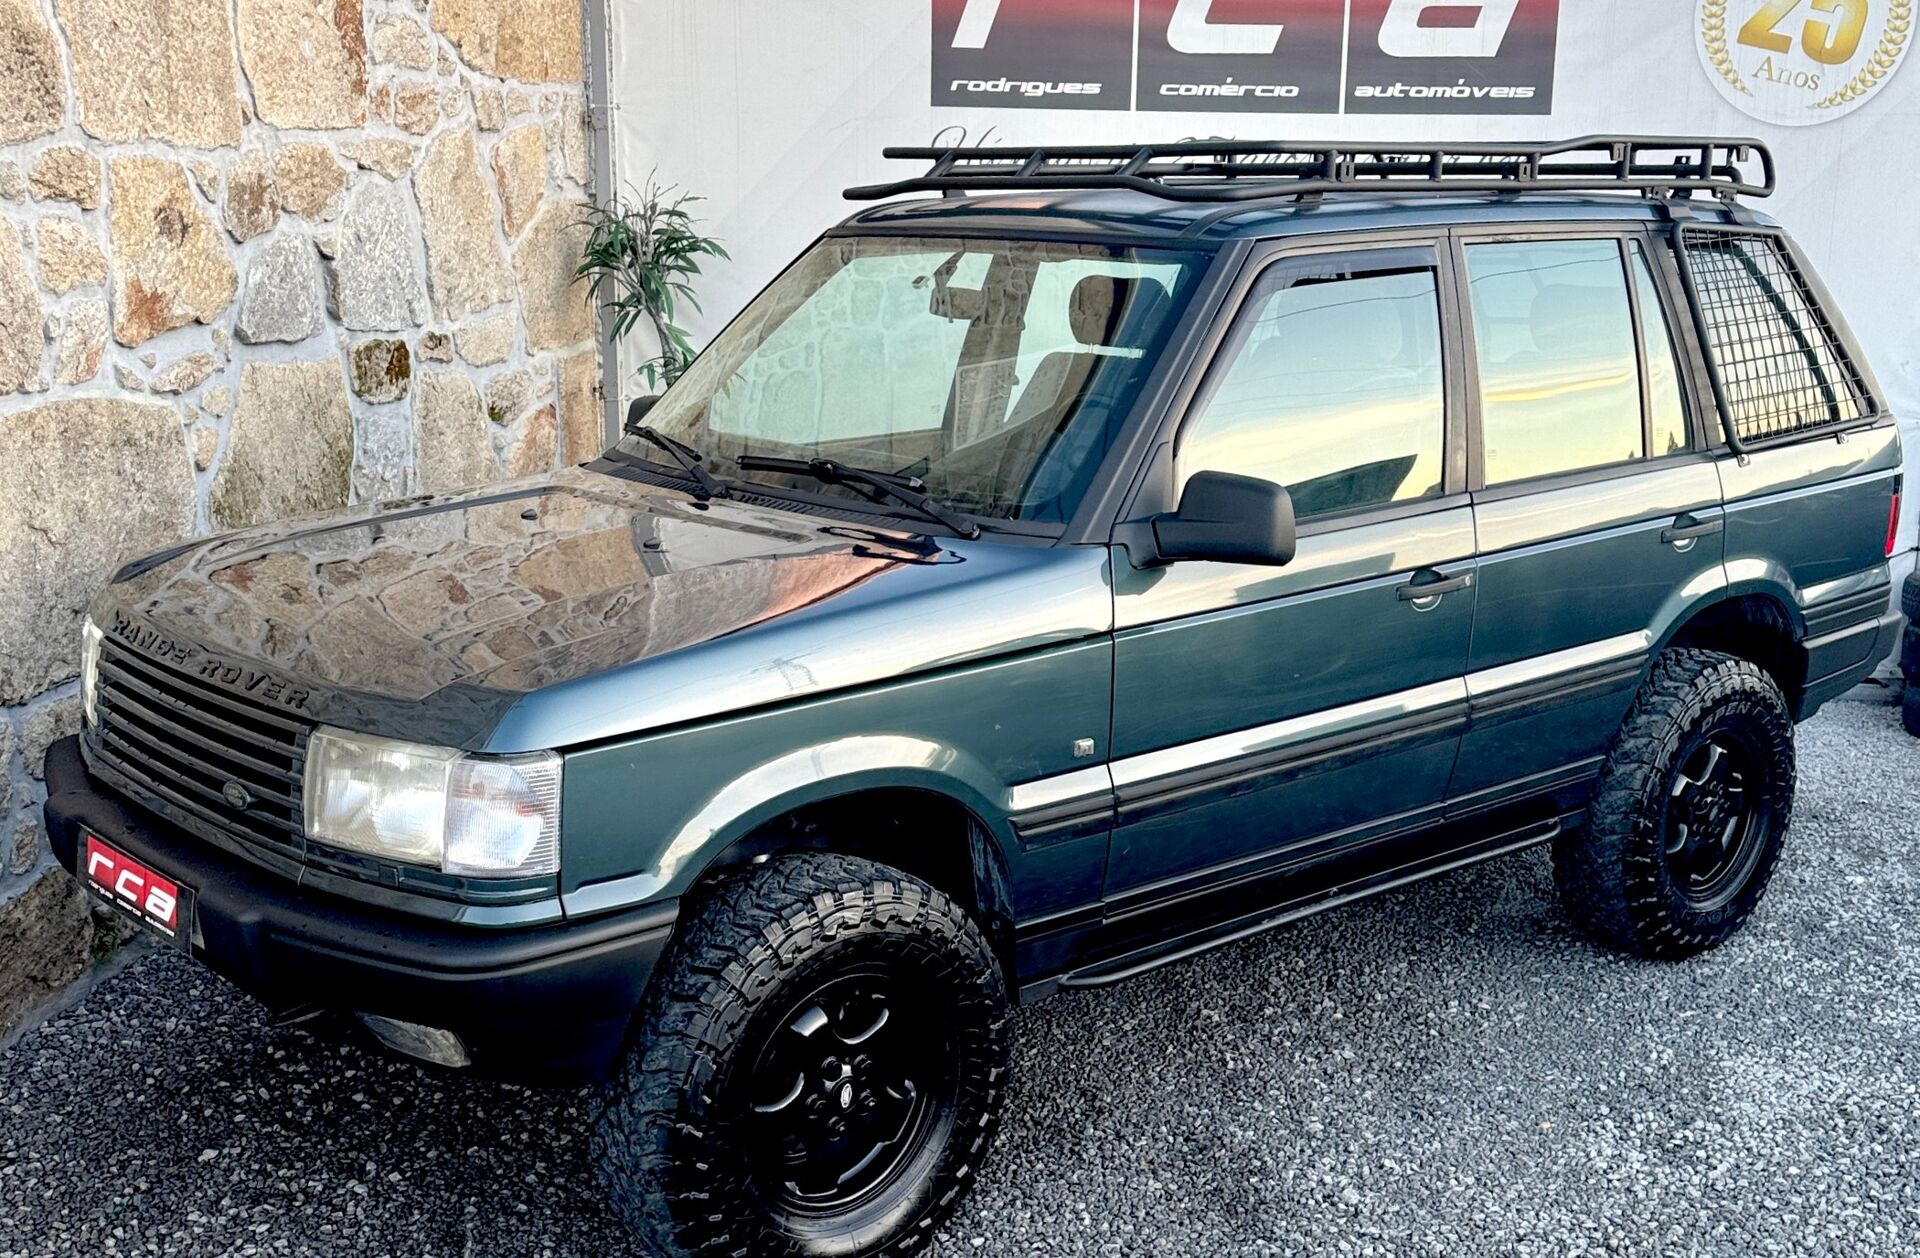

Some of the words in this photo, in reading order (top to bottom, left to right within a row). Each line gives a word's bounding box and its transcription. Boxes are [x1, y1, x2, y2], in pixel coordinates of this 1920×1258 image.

[950, 77, 1102, 97] rodrigues
[1159, 76, 1299, 98] comércio
[1354, 78, 1536, 99] automóveis
[1752, 55, 1821, 91] Anos
[112, 610, 194, 665] RANGE
[200, 659, 311, 709] ROVER
[88, 851, 177, 922] rca
